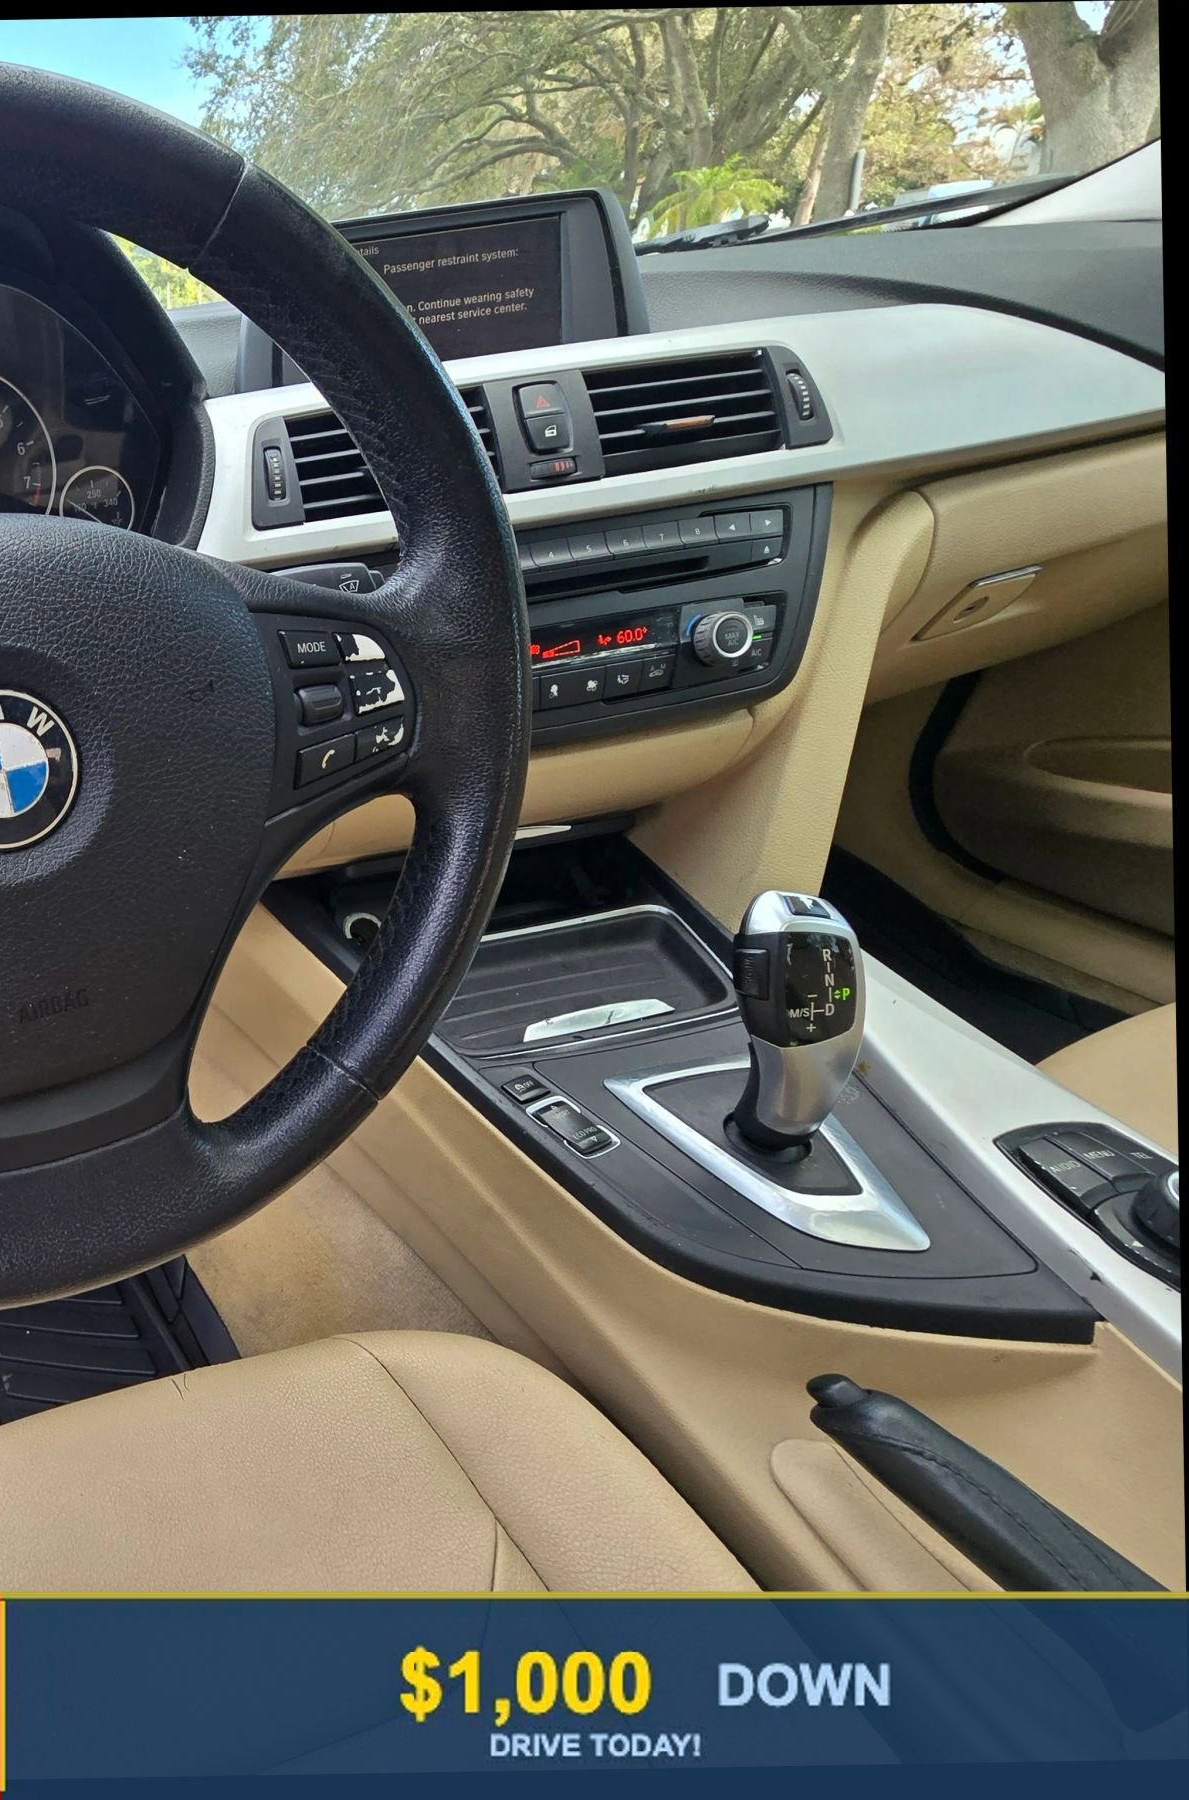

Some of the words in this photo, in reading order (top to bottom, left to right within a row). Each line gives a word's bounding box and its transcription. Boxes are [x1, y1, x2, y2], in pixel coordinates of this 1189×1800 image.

[383, 259, 435, 275] Passenger
[437, 252, 479, 267] restraint
[481, 248, 519, 264] system:
[418, 297, 461, 312] Continue
[463, 291, 502, 305] wearing
[504, 287, 534, 300] safety
[419, 311, 456, 325] nearest
[457, 307, 492, 320] service
[494, 302, 528, 315] center.
[17, 442, 25, 456] 6
[23, 476, 31, 489] 7
[695, 528, 701, 536] 8
[586, 544, 592, 553] 5
[623, 538, 629, 546] 6
[724, 631, 740, 640] MAX
[297, 642, 327, 654] MODE
[751, 649, 762, 657] A/C
[822, 949, 832, 962] R
[824, 973, 835, 987] N
[842, 988, 851, 1000] P
[19, 988, 89, 1024] AIRBAG
[789, 1007, 810, 1018] M/S
[825, 1003, 835, 1016] D
[1083, 1149, 1115, 1160] MENU
[1131, 1151, 1154, 1160] TEL
[1049, 1160, 1082, 1173] AUDIO
